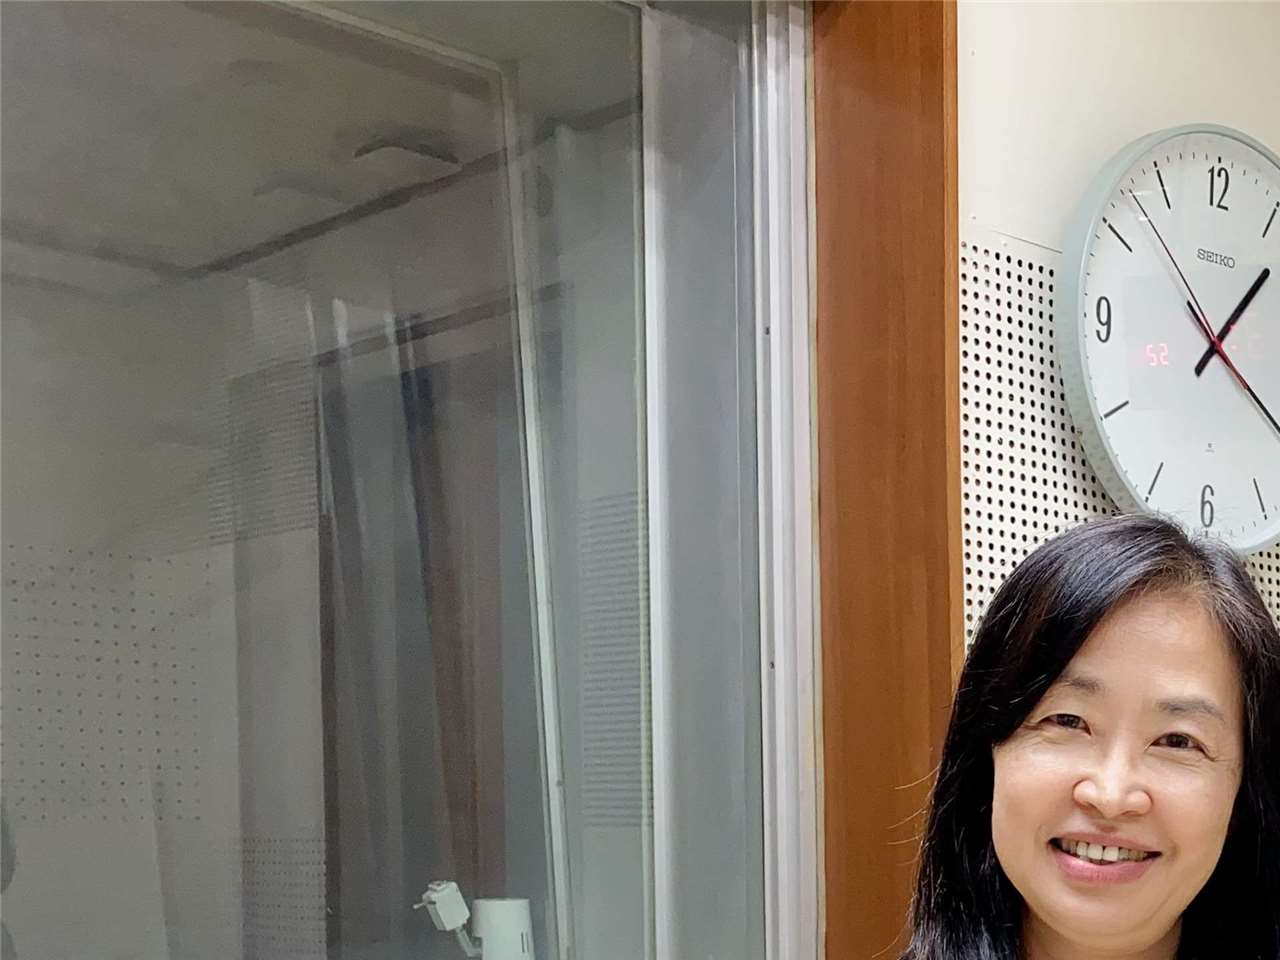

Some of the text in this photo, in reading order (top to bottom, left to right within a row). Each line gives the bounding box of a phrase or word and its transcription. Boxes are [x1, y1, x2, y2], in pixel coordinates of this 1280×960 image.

[1207, 165, 1230, 212] 12
[1197, 248, 1236, 269] SEIKO
[1095, 295, 1112, 343] 9
[1200, 484, 1214, 528] 6
